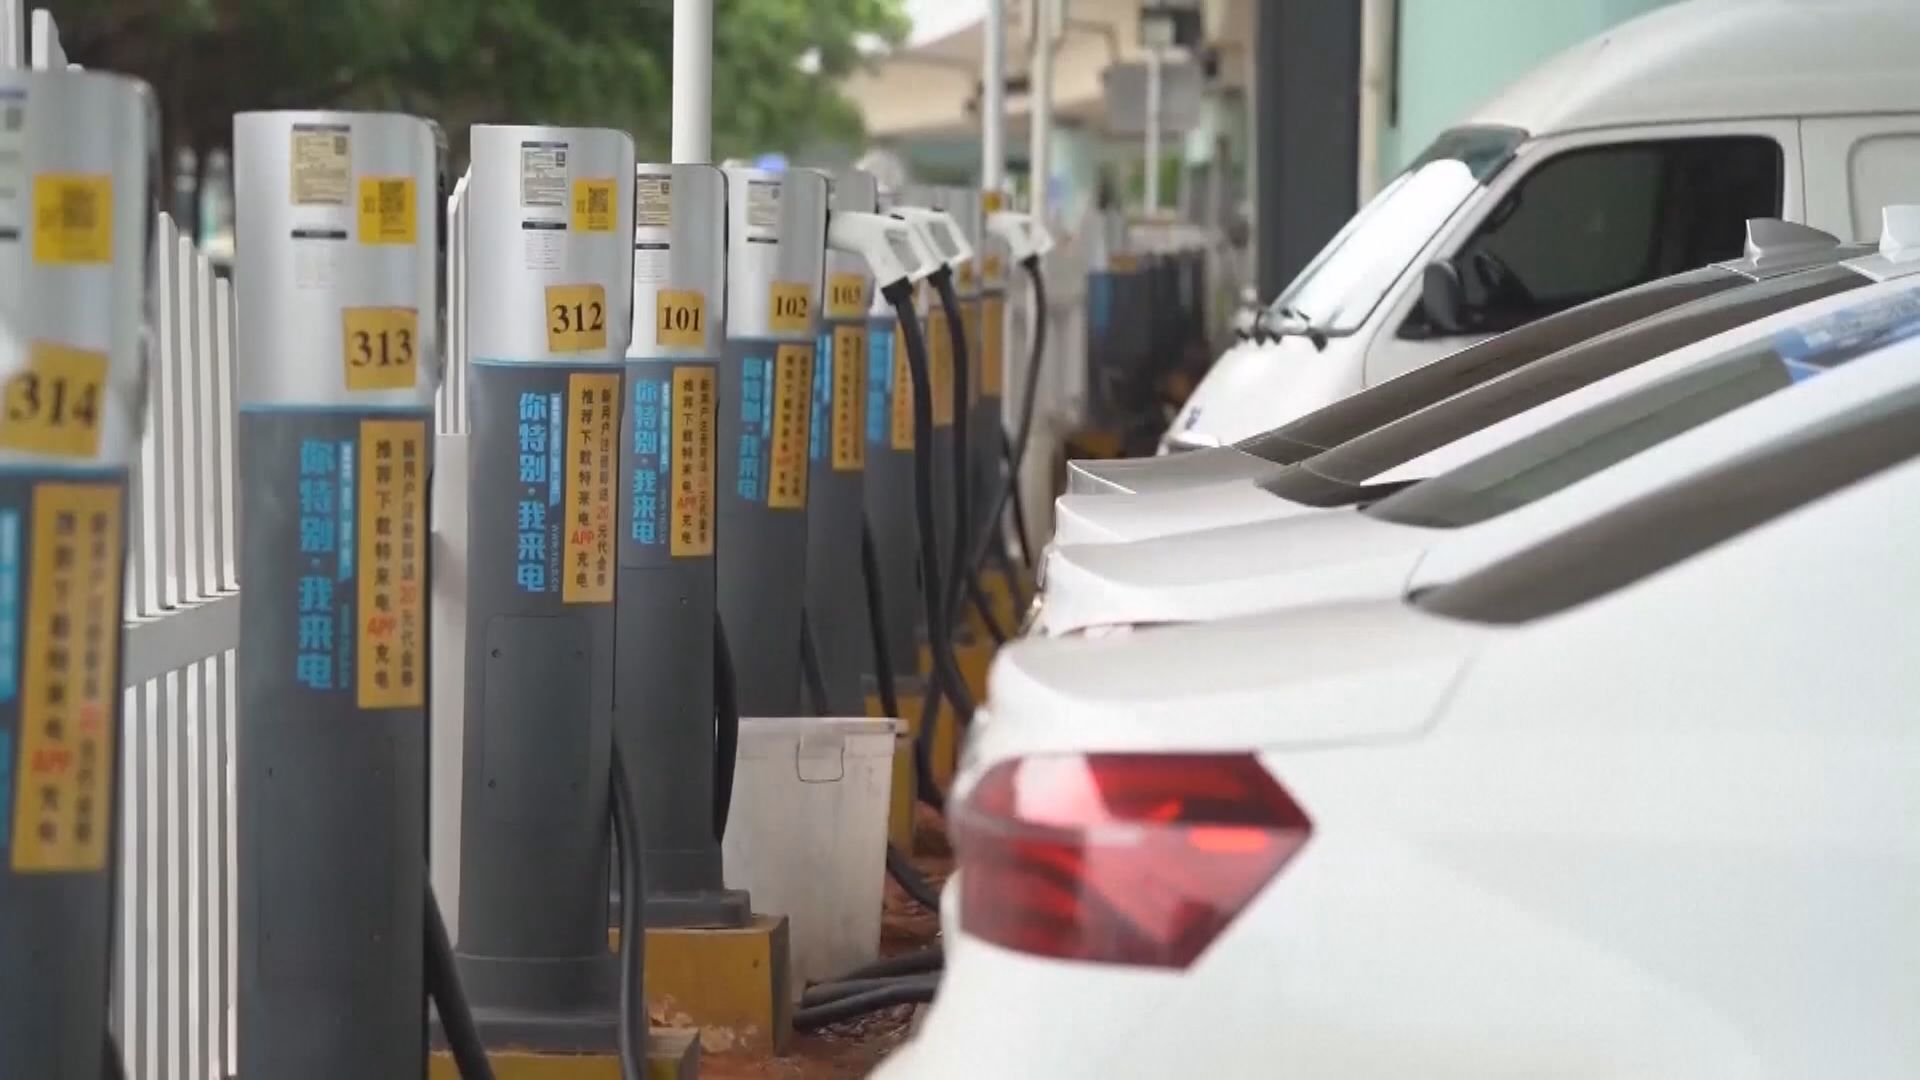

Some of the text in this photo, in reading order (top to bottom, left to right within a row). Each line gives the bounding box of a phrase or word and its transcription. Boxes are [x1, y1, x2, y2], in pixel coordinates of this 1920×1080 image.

[552, 302, 604, 334] 312
[662, 306, 701, 332] 101
[776, 295, 808, 318] 102
[351, 329, 413, 367] 313
[9, 371, 97, 430] 314
